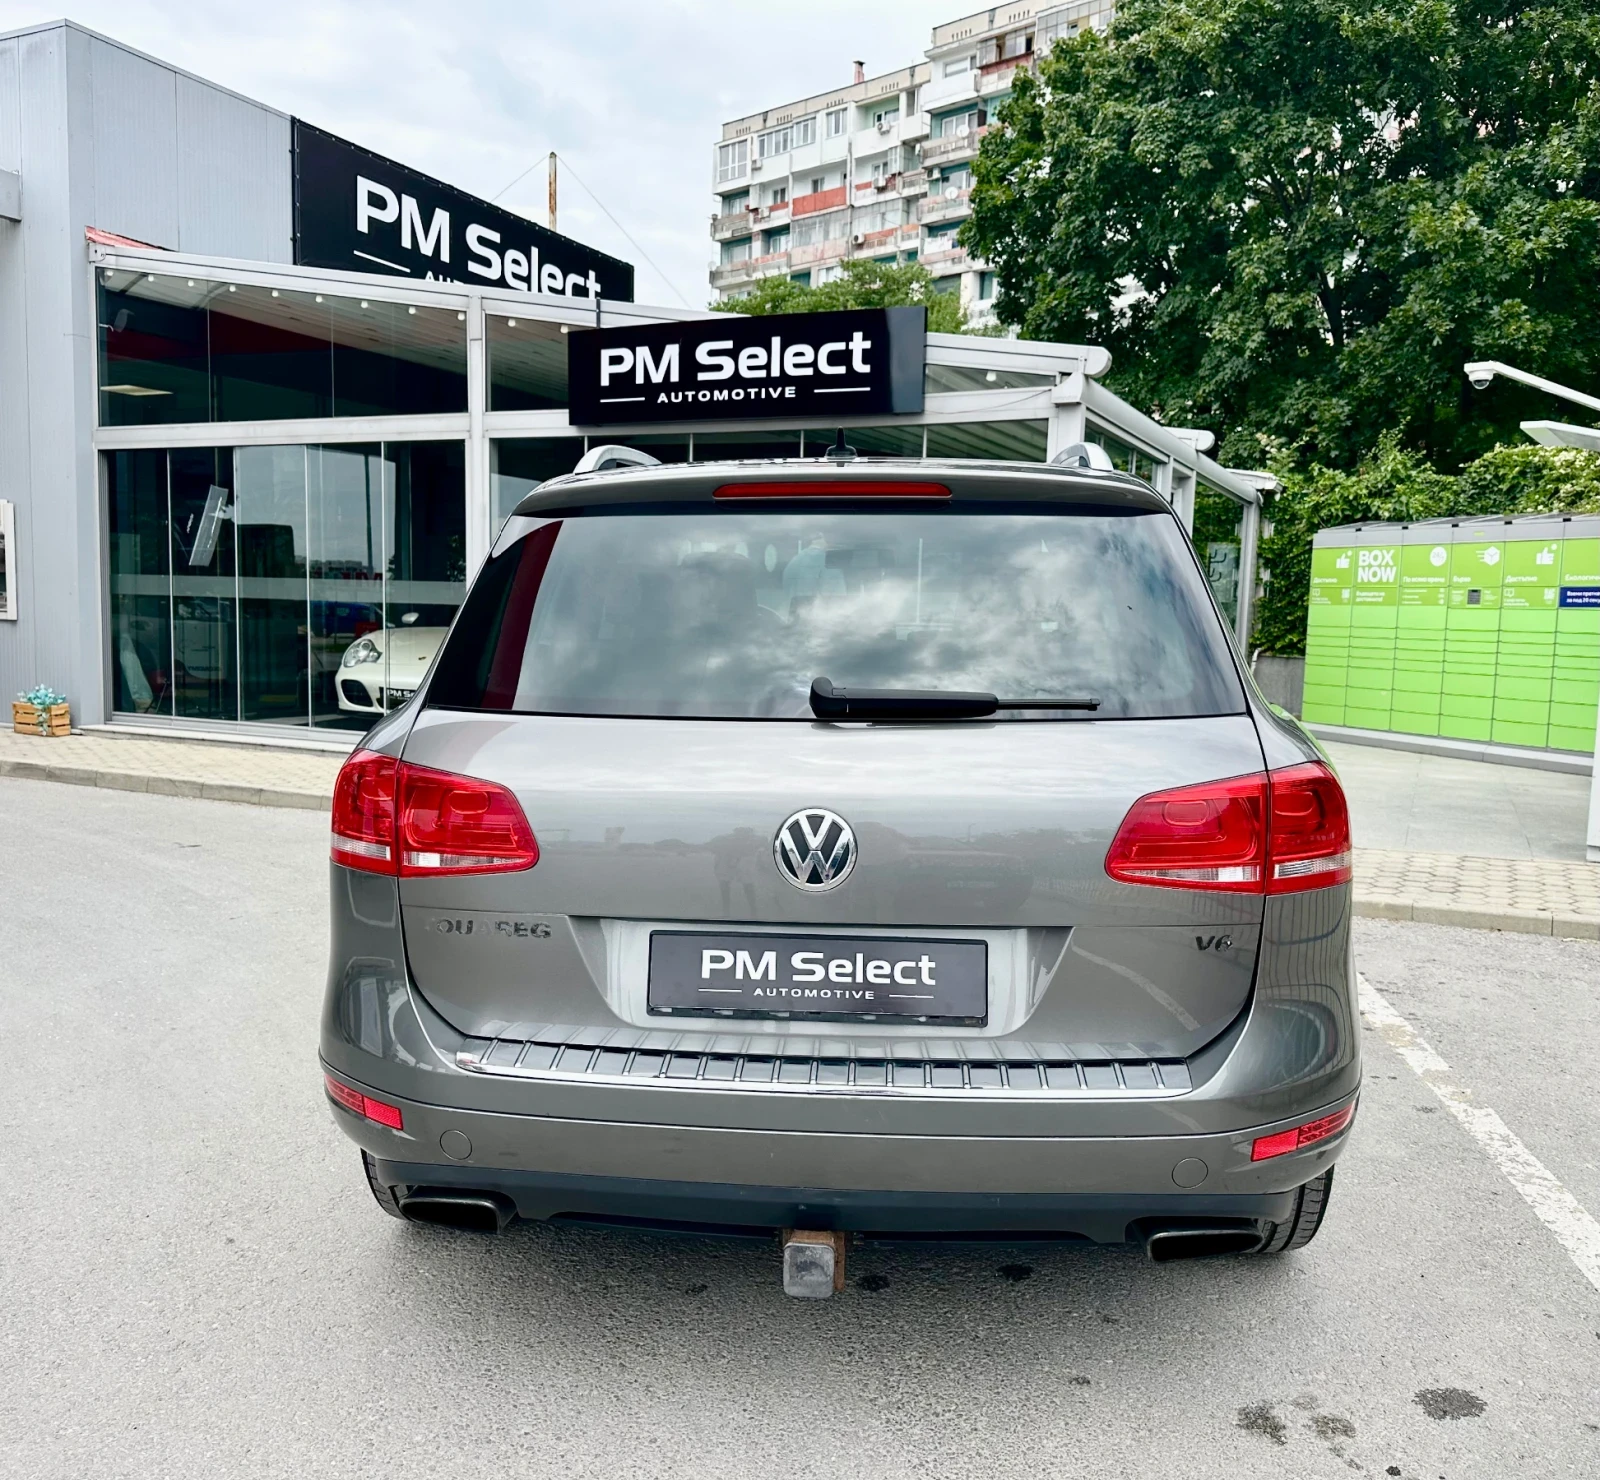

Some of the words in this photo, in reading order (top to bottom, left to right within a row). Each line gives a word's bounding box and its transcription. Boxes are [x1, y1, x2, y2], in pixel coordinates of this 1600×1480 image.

[356, 175, 450, 264] PM
[465, 223, 602, 299] Select
[600, 344, 680, 387] PM
[695, 331, 872, 381] Select
[657, 386, 797, 404] AUTOMOTIVE
[1358, 549, 1395, 566] BOX
[1357, 566, 1397, 583] NOW
[1195, 934, 1234, 953] V6
[700, 949, 777, 980] PM
[790, 951, 936, 985] Select
[753, 987, 875, 1000] AUTOMOTIVE
